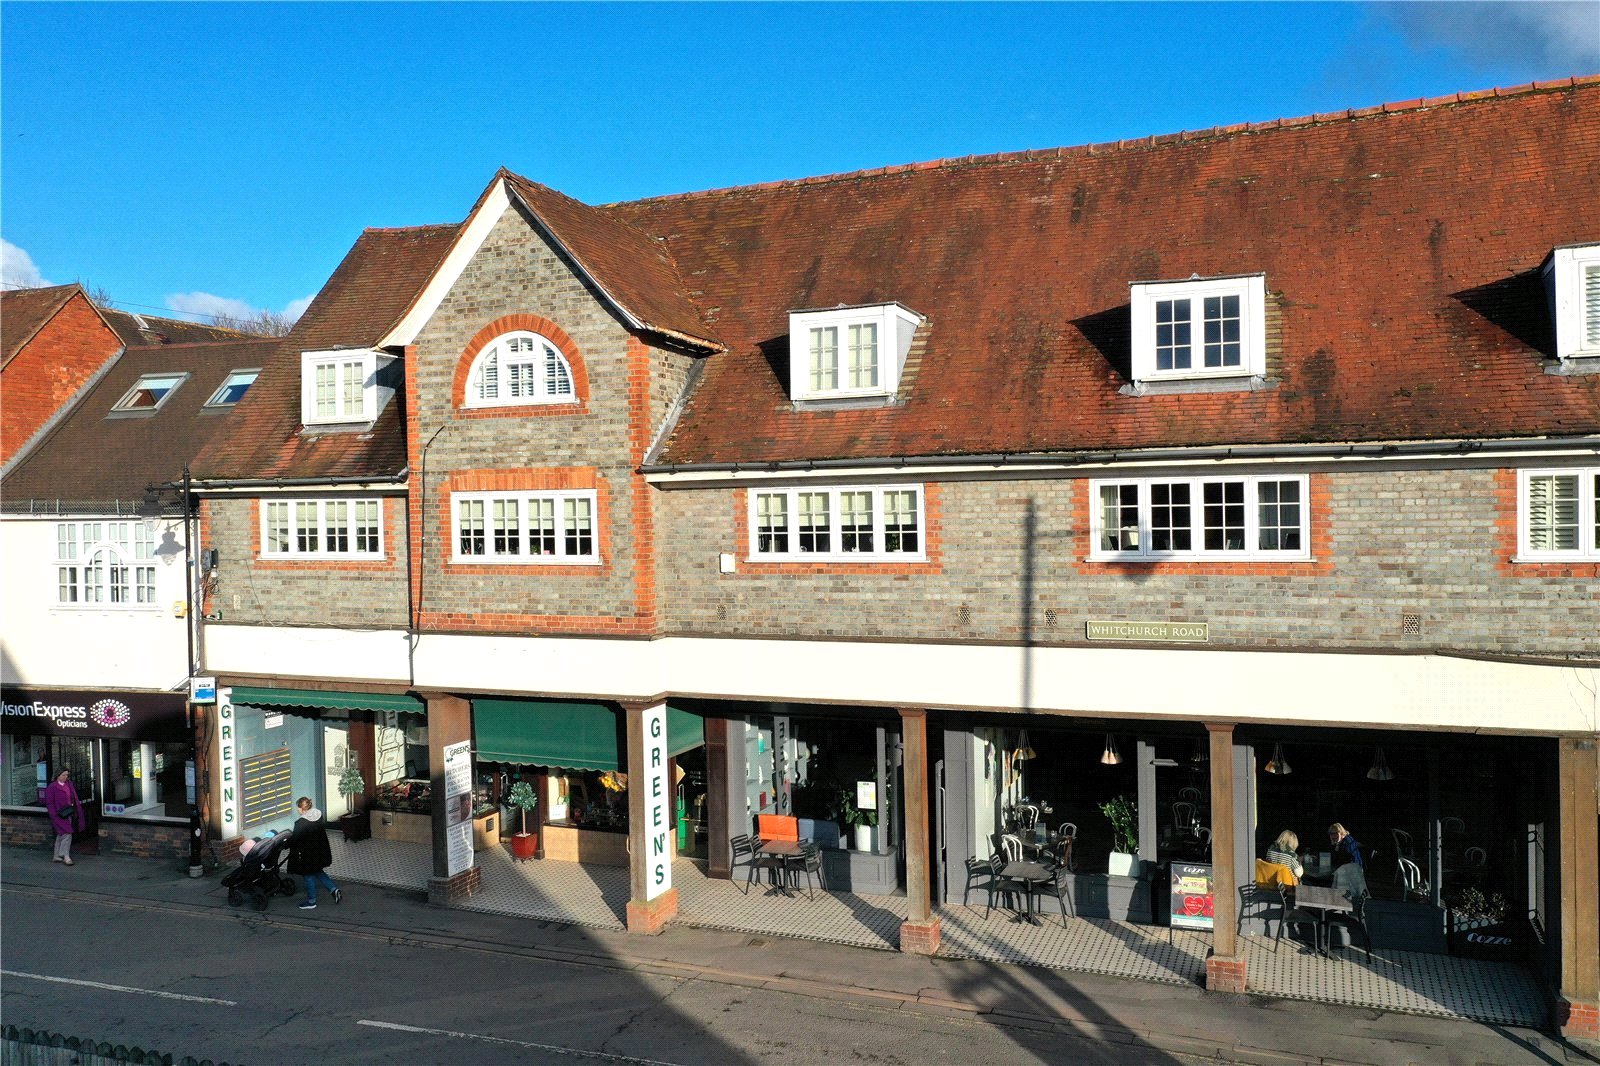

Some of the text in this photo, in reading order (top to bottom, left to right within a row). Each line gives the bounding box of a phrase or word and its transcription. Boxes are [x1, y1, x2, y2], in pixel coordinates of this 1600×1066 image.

[1091, 625, 1204, 637] WHITCHURCH ROAD
[56, 719, 88, 729] Opticians
[221, 704, 234, 822] GREENS
[651, 717, 666, 885] GREEN'S
[1467, 933, 1512, 945] Cozze
